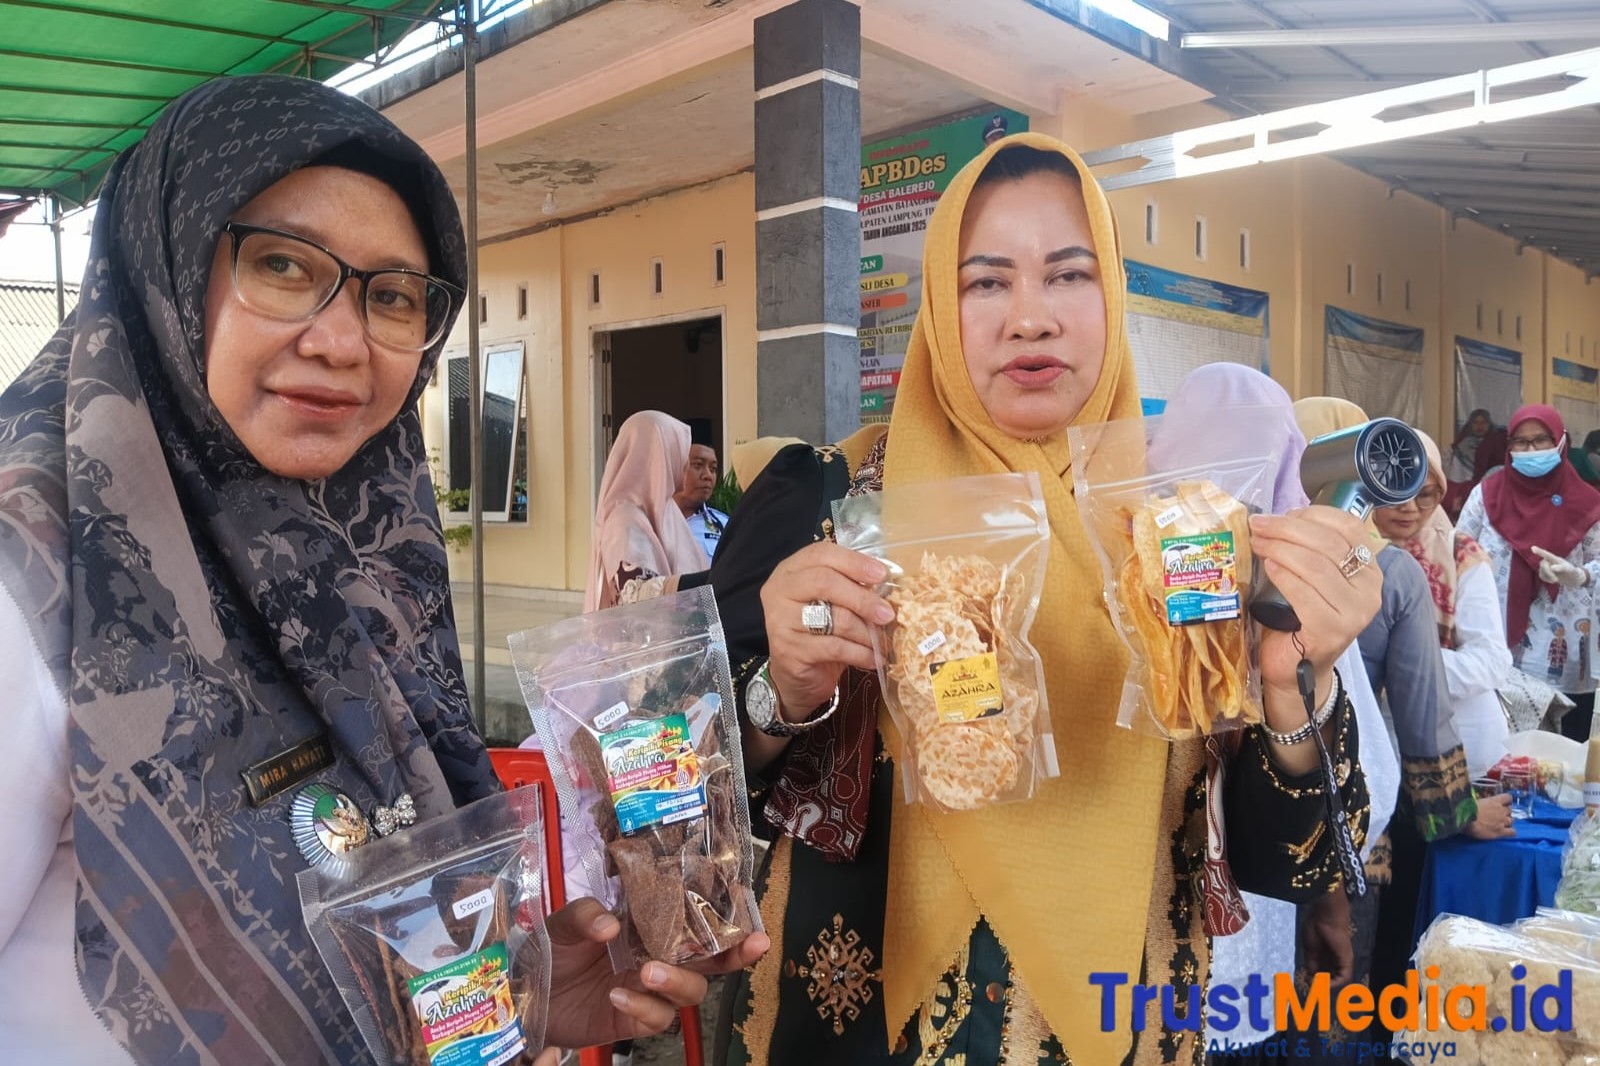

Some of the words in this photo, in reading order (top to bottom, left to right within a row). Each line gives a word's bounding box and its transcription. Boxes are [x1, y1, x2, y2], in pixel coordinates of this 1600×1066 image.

[860, 153, 947, 189] APBDes
[863, 191, 886, 204] DESA
[888, 180, 935, 198] BALEREJO
[888, 210, 922, 223] LAMPUNG
[863, 228, 880, 241] TAHUN
[881, 222, 910, 238] ANGGARAN
[911, 219, 927, 232] 2025
[874, 278, 894, 289] DESA
[942, 682, 995, 699] AZAHRA
[259, 765, 288, 789] MIRA
[291, 745, 326, 772] HAYATI
[612, 751, 666, 777] Azahra
[459, 895, 487, 914] 5000
[444, 981, 477, 1001] Keripik
[426, 991, 486, 1026] Azahra
